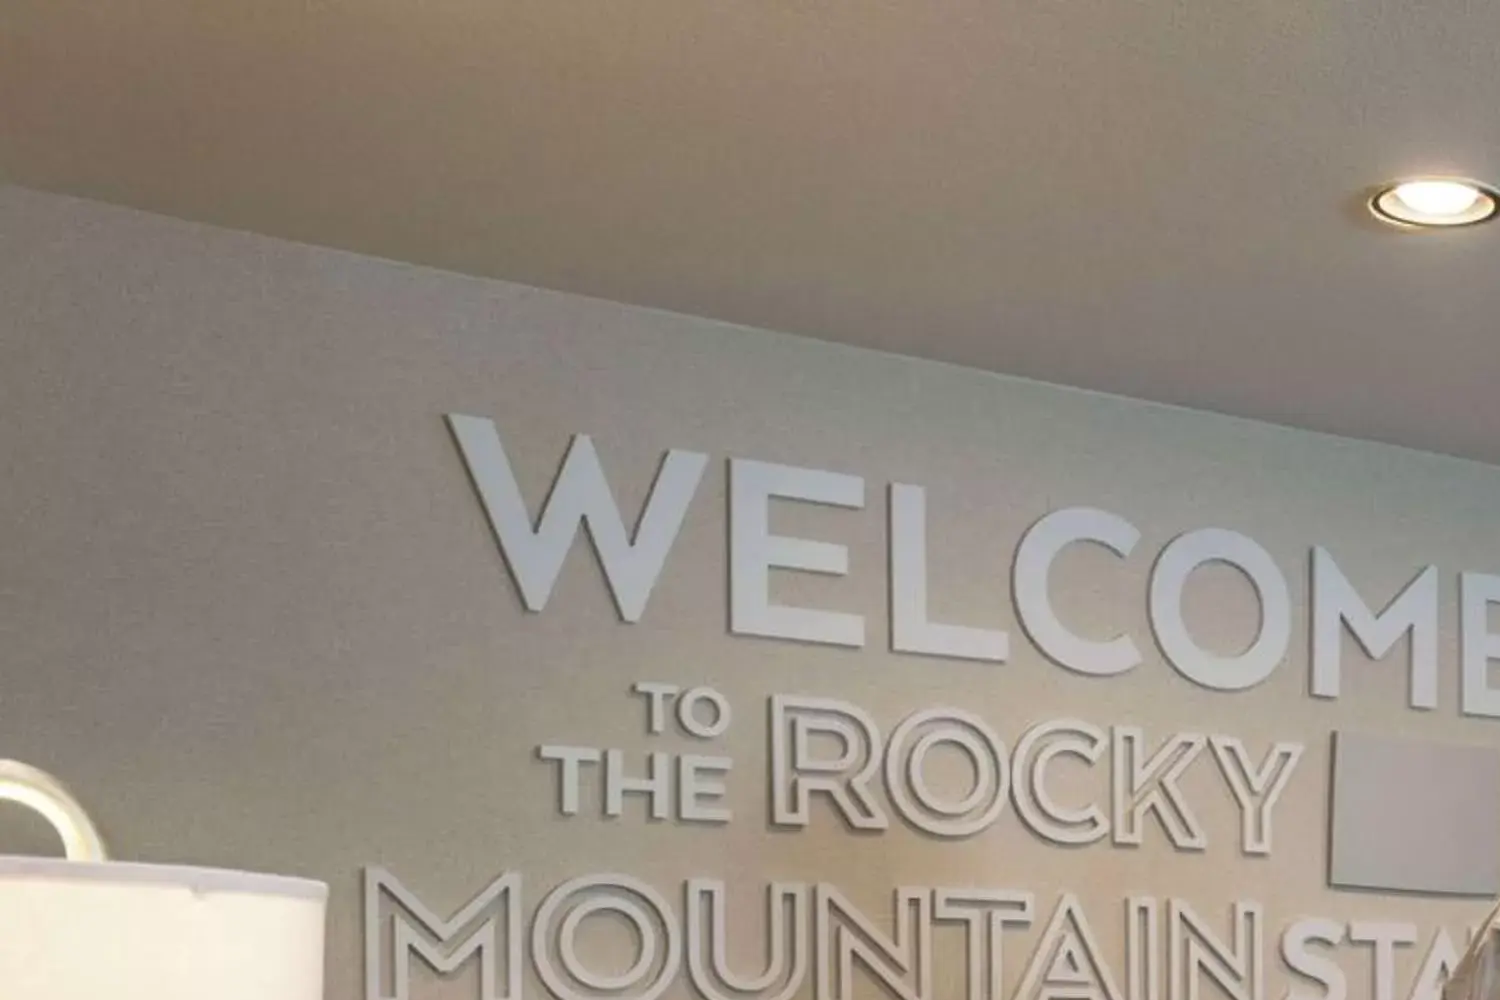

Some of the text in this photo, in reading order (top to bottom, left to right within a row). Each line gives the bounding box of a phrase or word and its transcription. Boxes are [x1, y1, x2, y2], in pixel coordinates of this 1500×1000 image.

[633, 682, 731, 739] TO
[537, 692, 1303, 857] THE ROCKY
